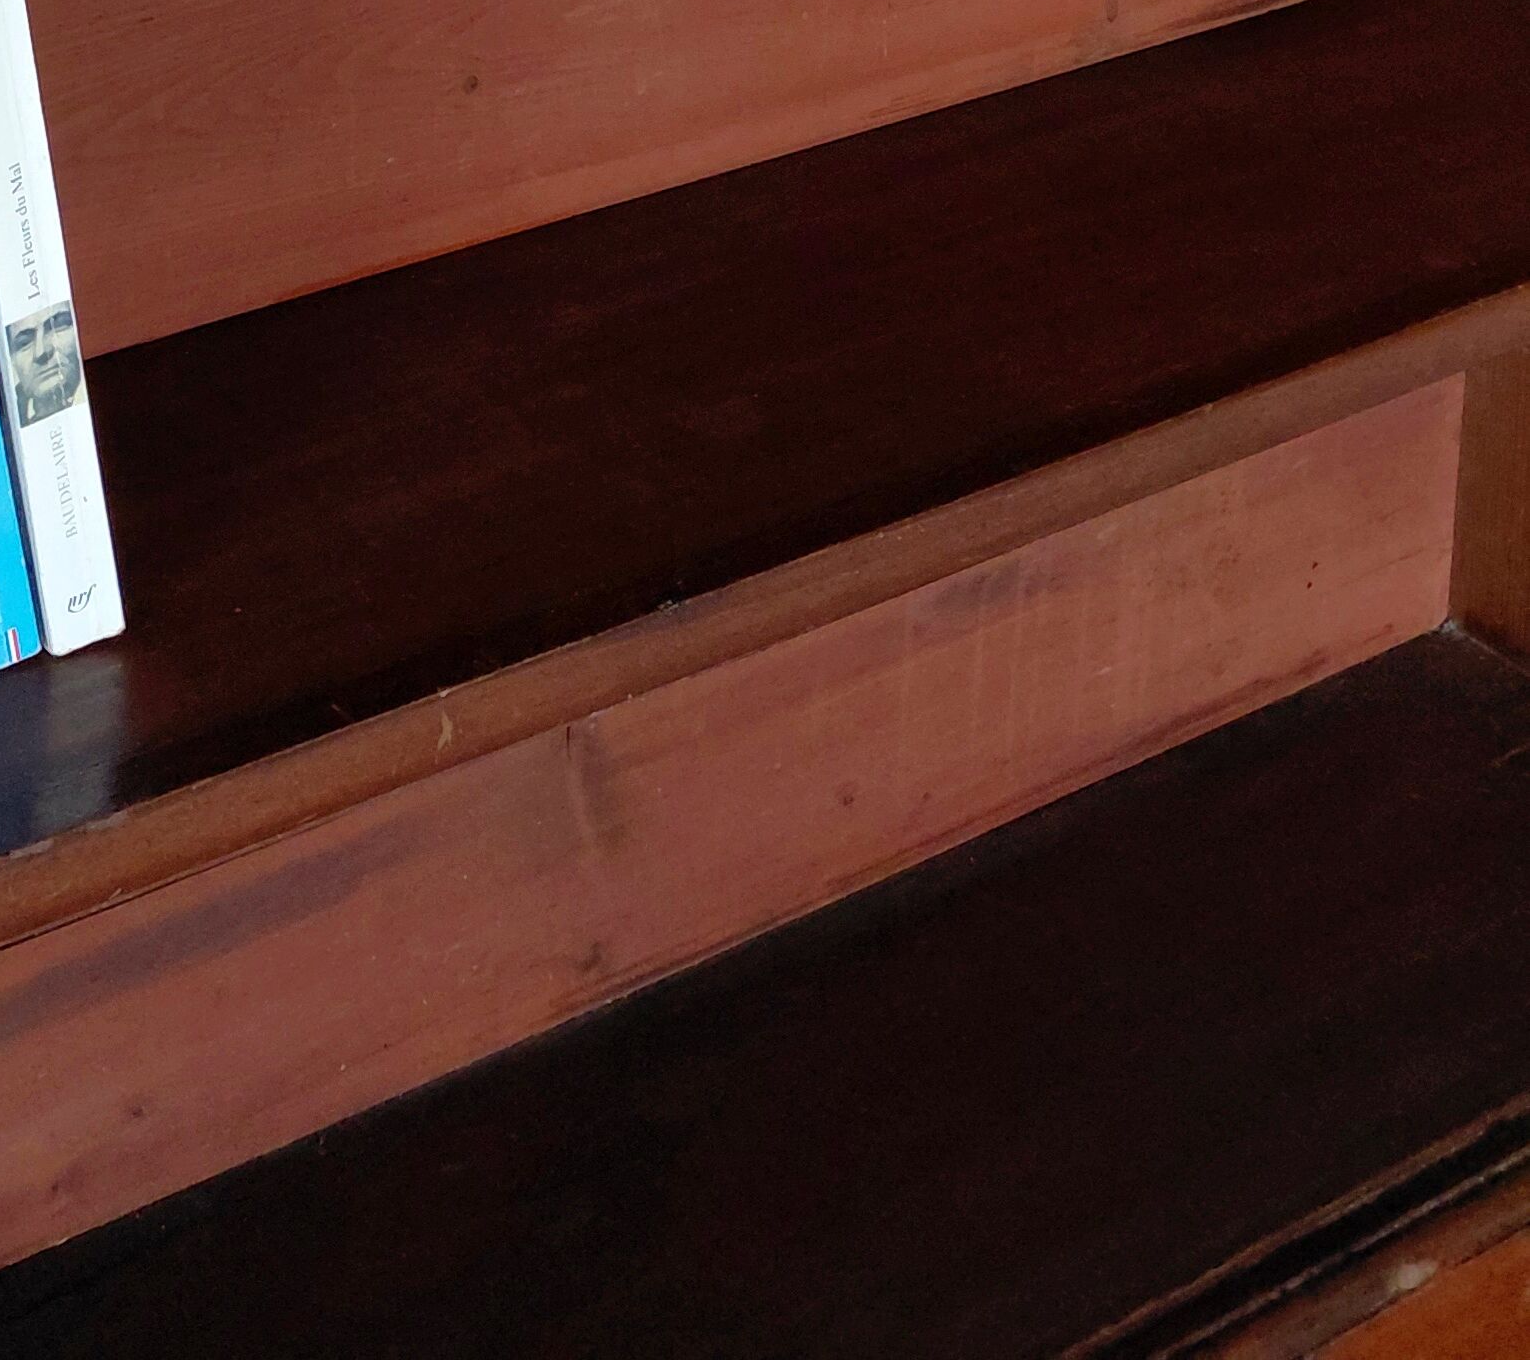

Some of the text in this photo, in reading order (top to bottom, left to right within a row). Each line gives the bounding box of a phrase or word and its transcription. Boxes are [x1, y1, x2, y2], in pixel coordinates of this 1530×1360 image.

[8, 162, 40, 300] Les Fleurs du Mal
[49, 426, 78, 538] BAUDELAIRE
